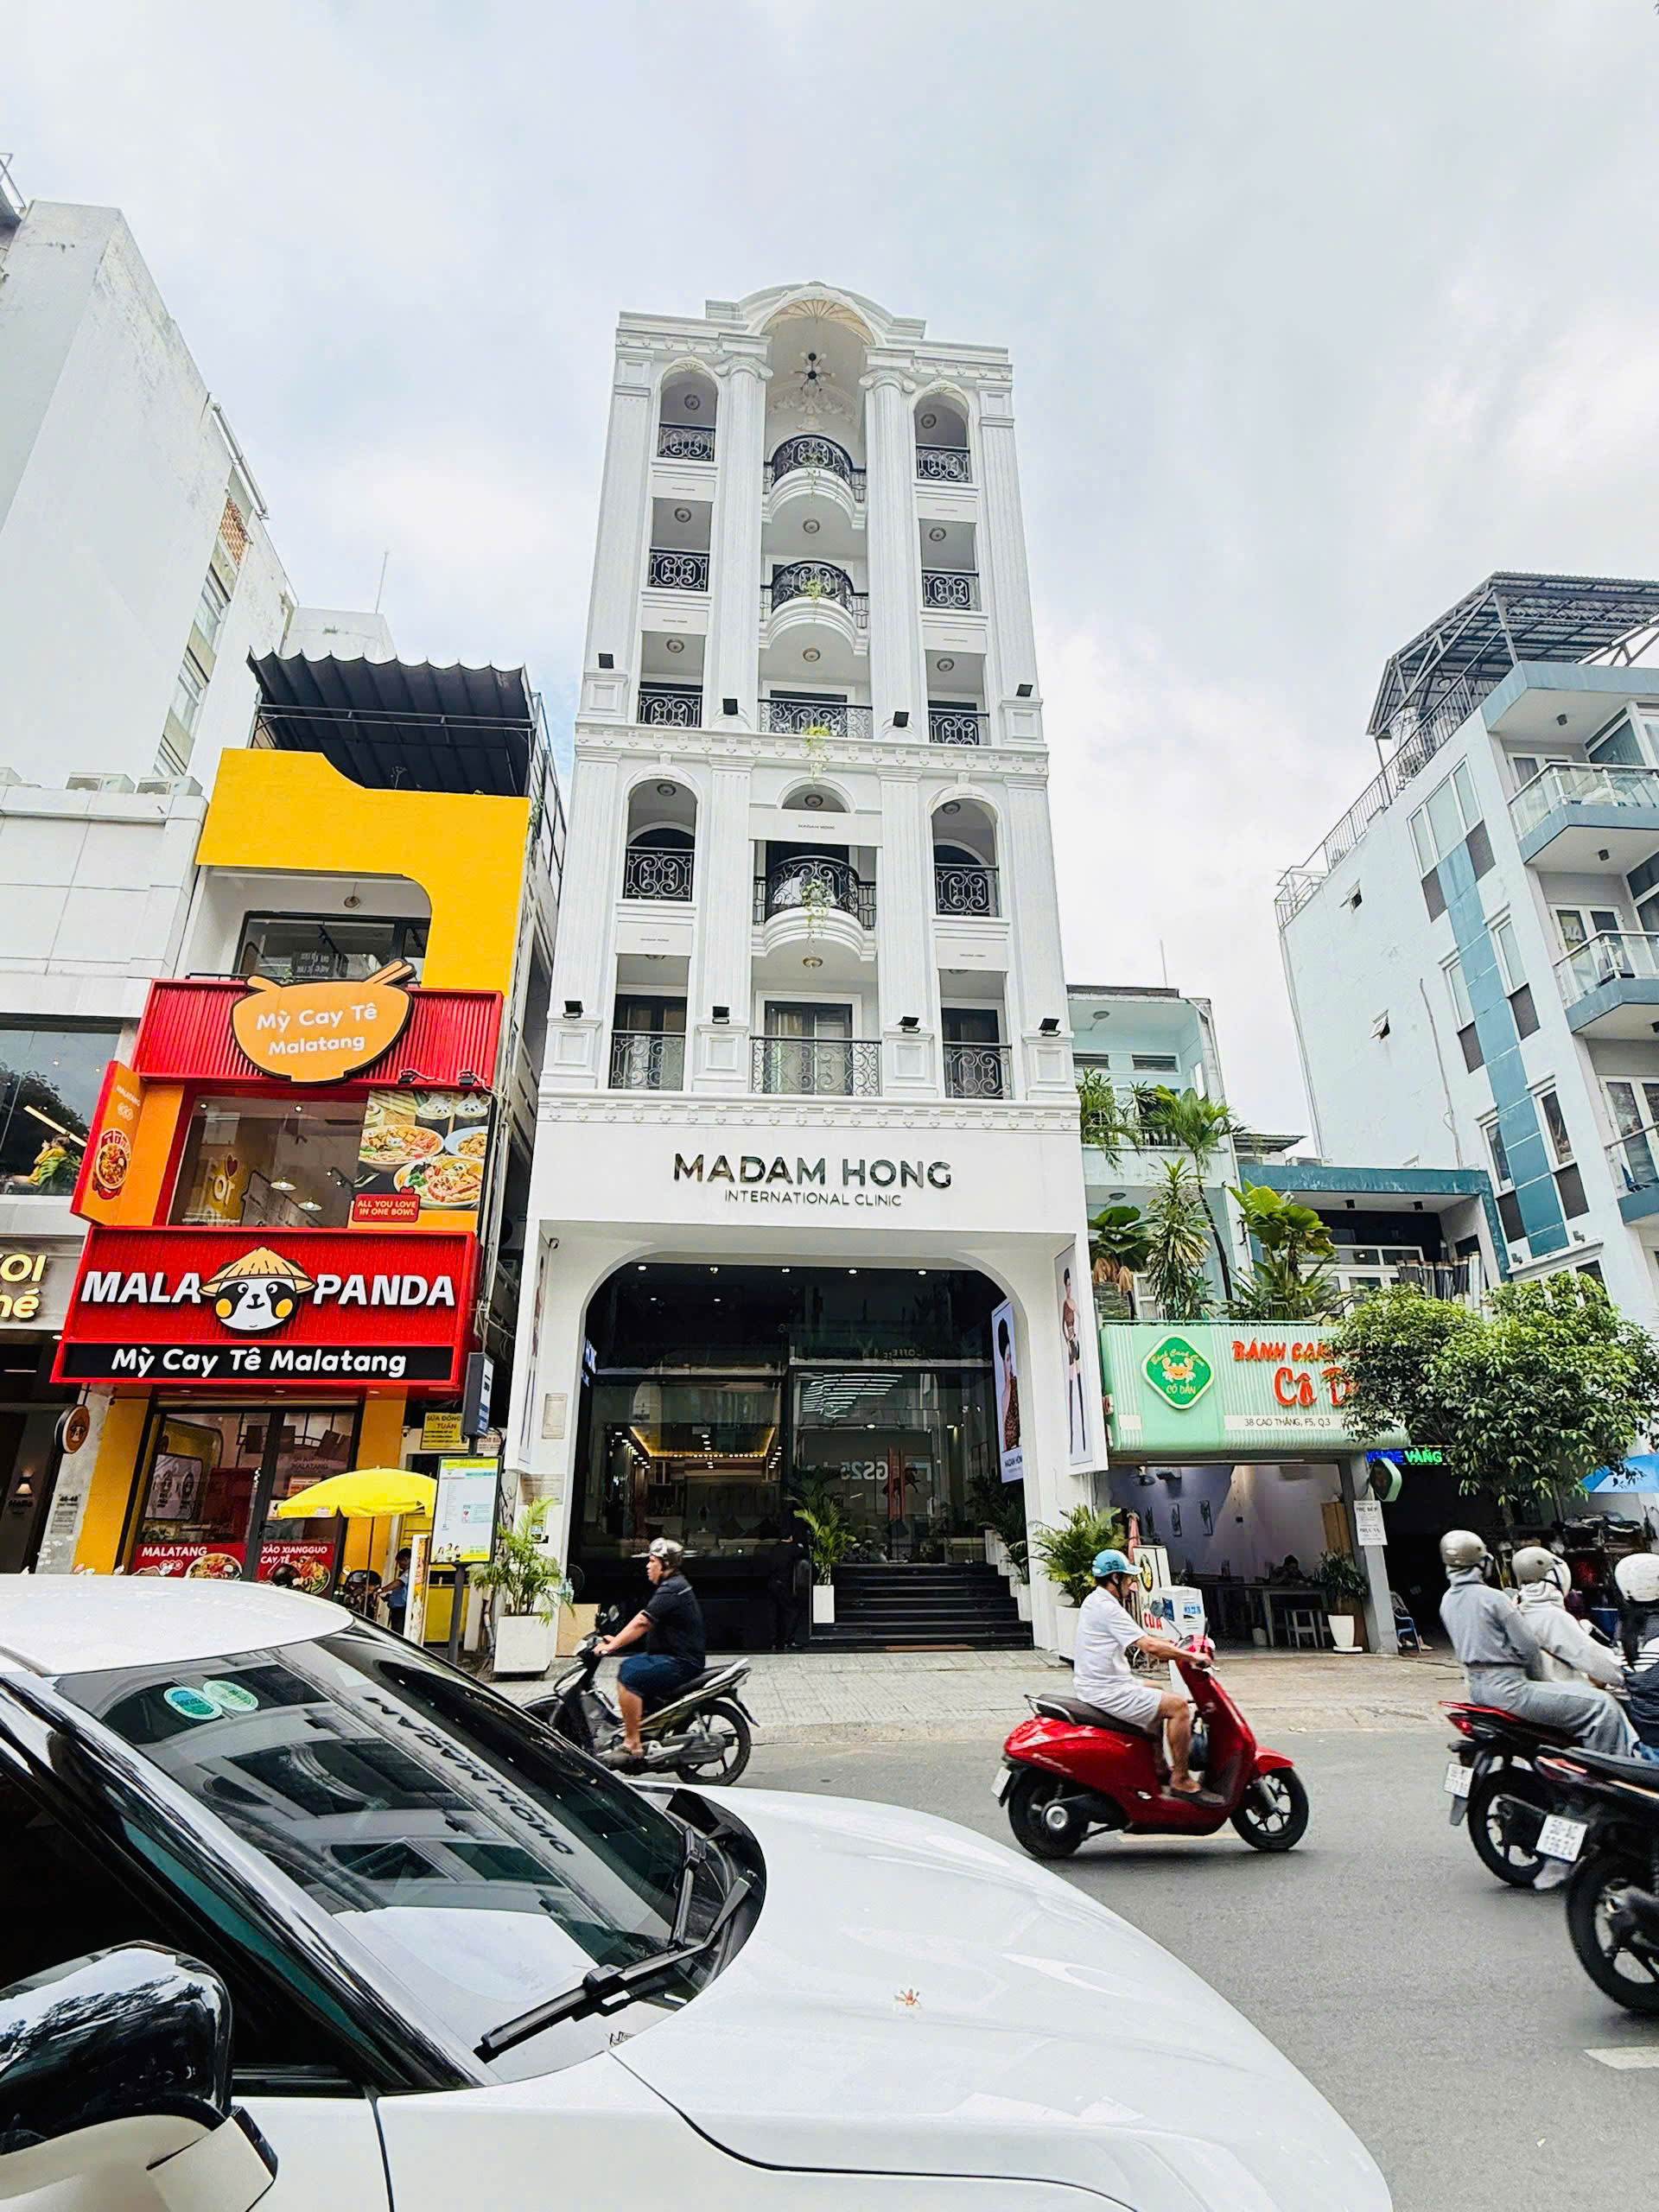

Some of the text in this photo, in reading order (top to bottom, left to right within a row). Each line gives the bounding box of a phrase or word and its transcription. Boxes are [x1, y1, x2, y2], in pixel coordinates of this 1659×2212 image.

[257, 1002, 378, 1033] Mỳ Cay Tê
[268, 1037, 365, 1055] Malatang
[674, 1153, 951, 1188] MADAM HONG
[725, 1190, 901, 1206] INTERNATIONAL CLINIC
[0, 1253, 47, 1282] OI
[81, 1271, 455, 1306] MALA PANDA
[111, 1346, 407, 1378] Mỳ Cay Tê Malatang
[1232, 1337, 1287, 1362] BÁNH
[1274, 1367, 1318, 1408] Cô
[1244, 1418, 1254, 1427] 38
[1255, 1418, 1273, 1427] CAO
[142, 1546, 208, 1557] MALATANG
[260, 1555, 277, 1564] CAY
[282, 1546, 327, 1554] XIANGGUO
